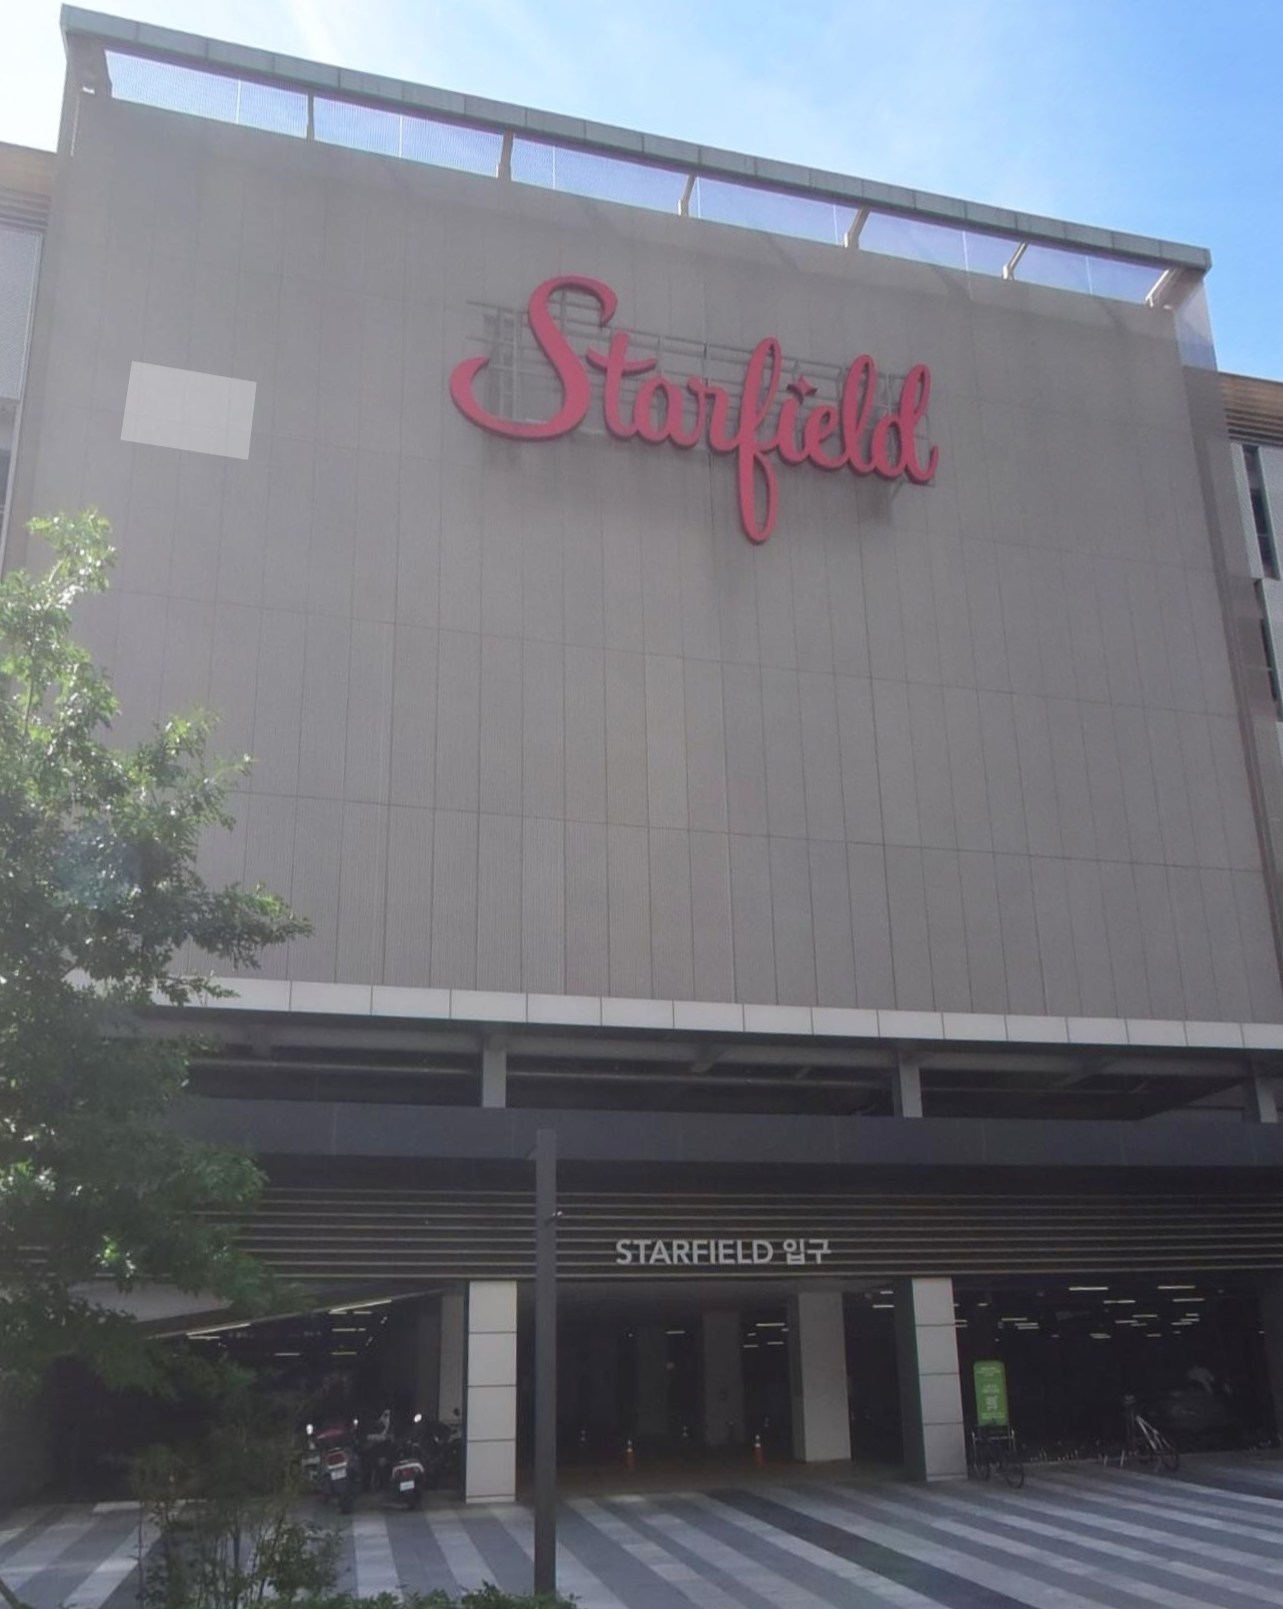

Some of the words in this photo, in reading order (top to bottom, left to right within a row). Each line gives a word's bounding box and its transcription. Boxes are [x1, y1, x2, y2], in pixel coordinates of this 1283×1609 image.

[449, 275, 939, 545] Starfield
[615, 1238, 774, 1265] STARFIELD
[782, 1238, 832, 1265] 입구
